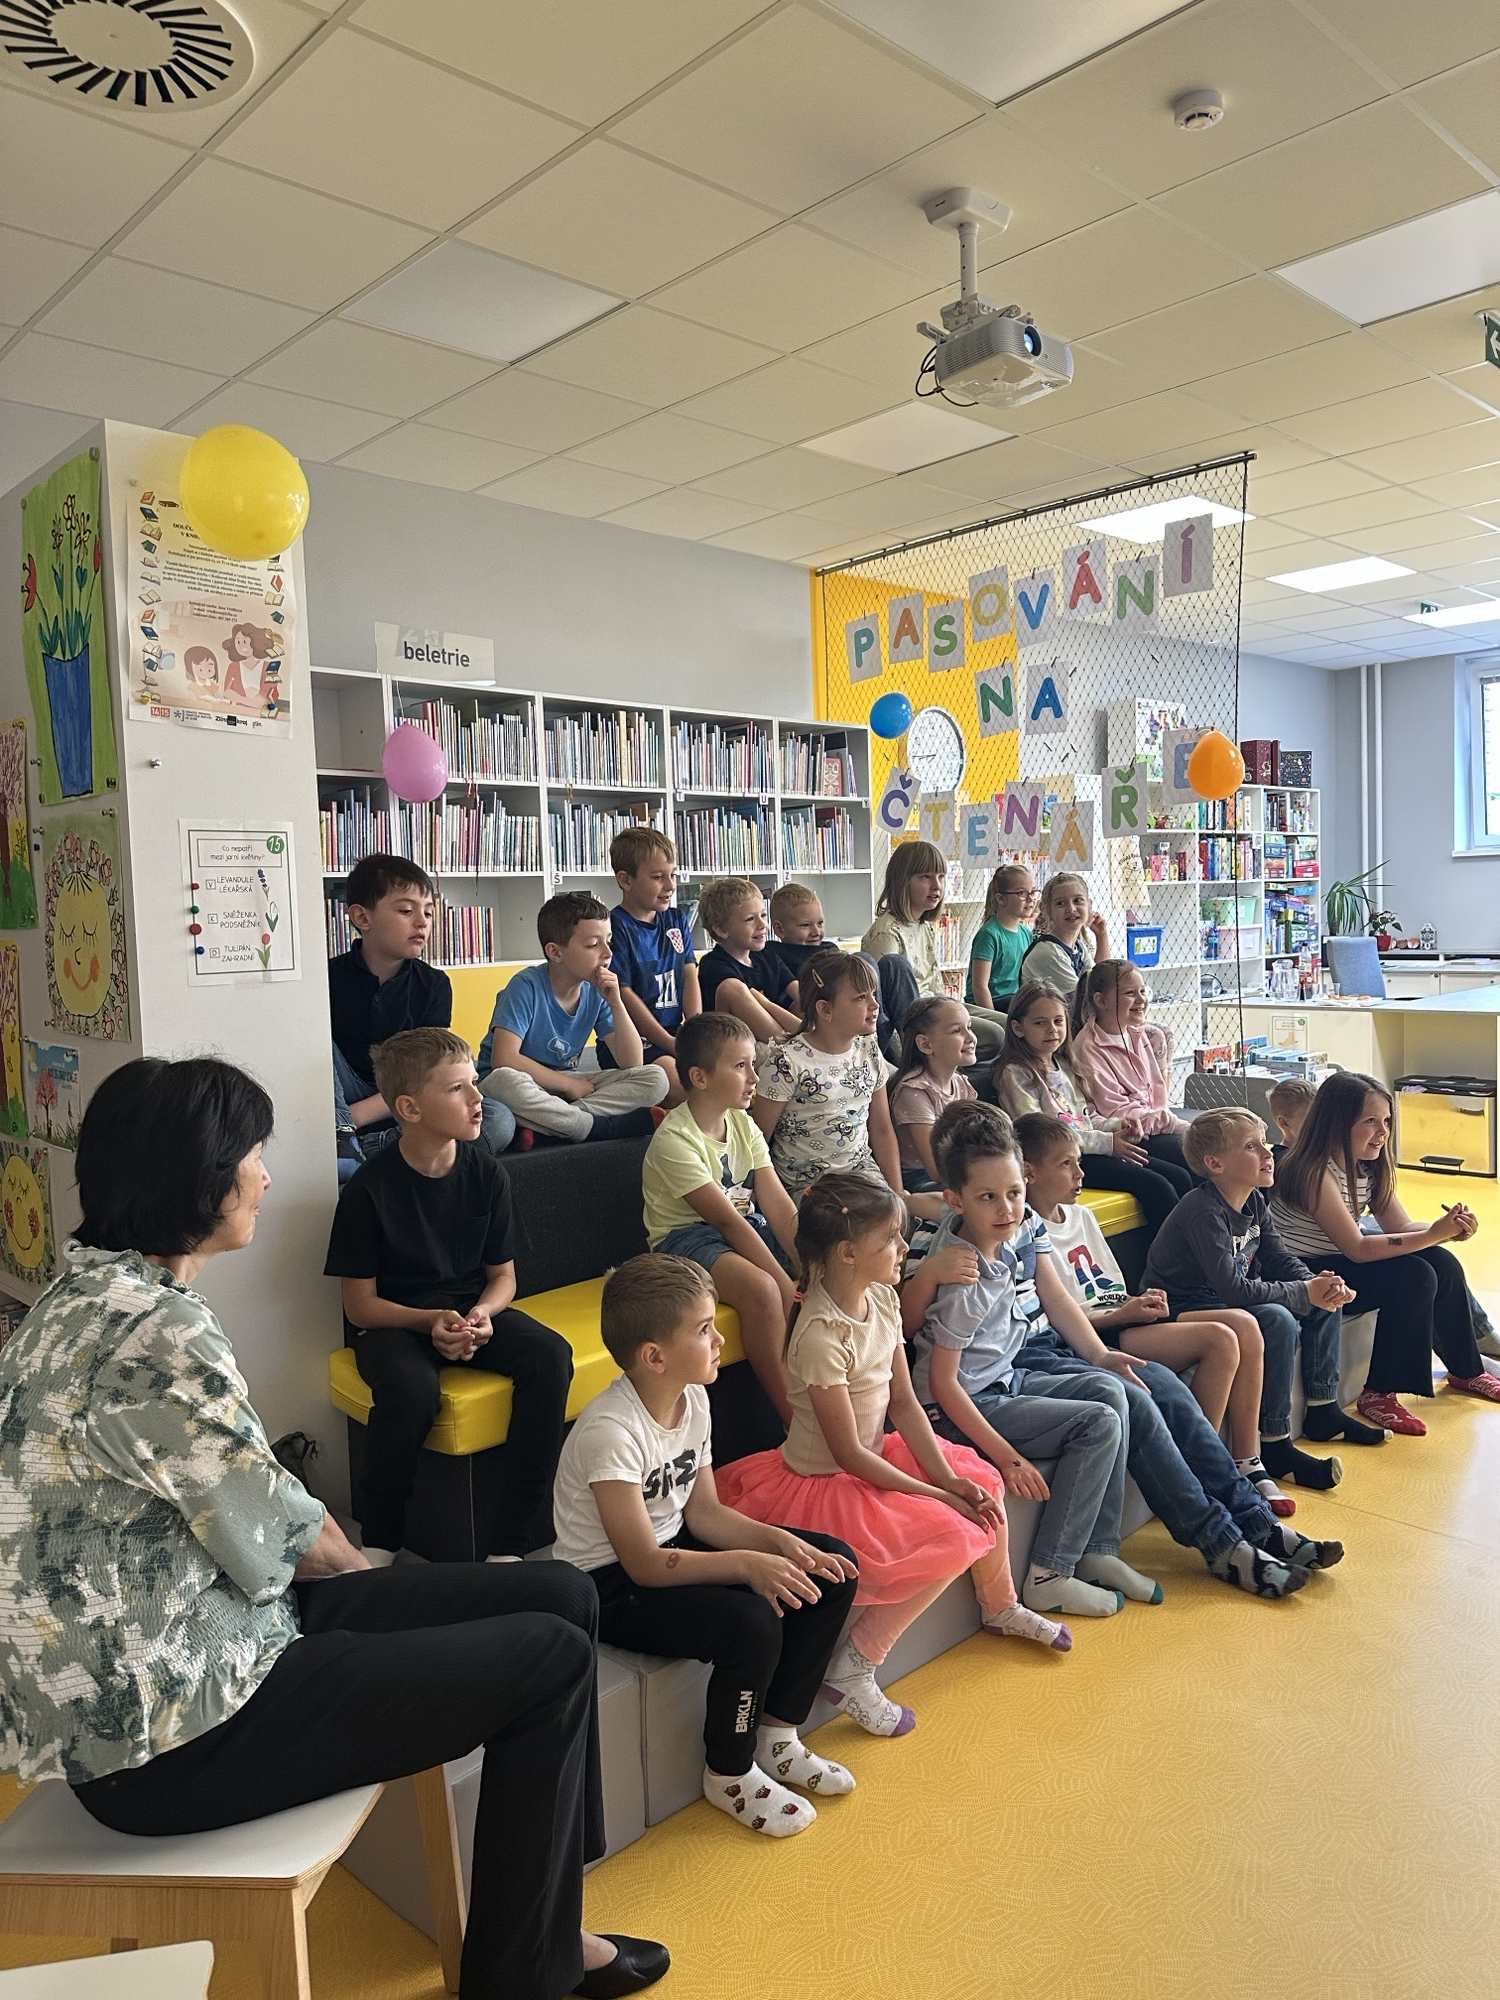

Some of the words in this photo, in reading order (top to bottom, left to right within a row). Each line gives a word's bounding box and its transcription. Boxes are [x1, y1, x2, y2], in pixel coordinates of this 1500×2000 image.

[853, 523, 1194, 668] PASOVÁNÍ
[403, 640, 470, 668] beletrie
[979, 674, 1063, 724] NA
[268, 837, 281, 852] 15
[216, 875, 255, 884] LEVANDULE
[554, 872, 561, 884] Š
[654, 969, 679, 1009] 10
[735, 1690, 753, 1733] BRKLN
